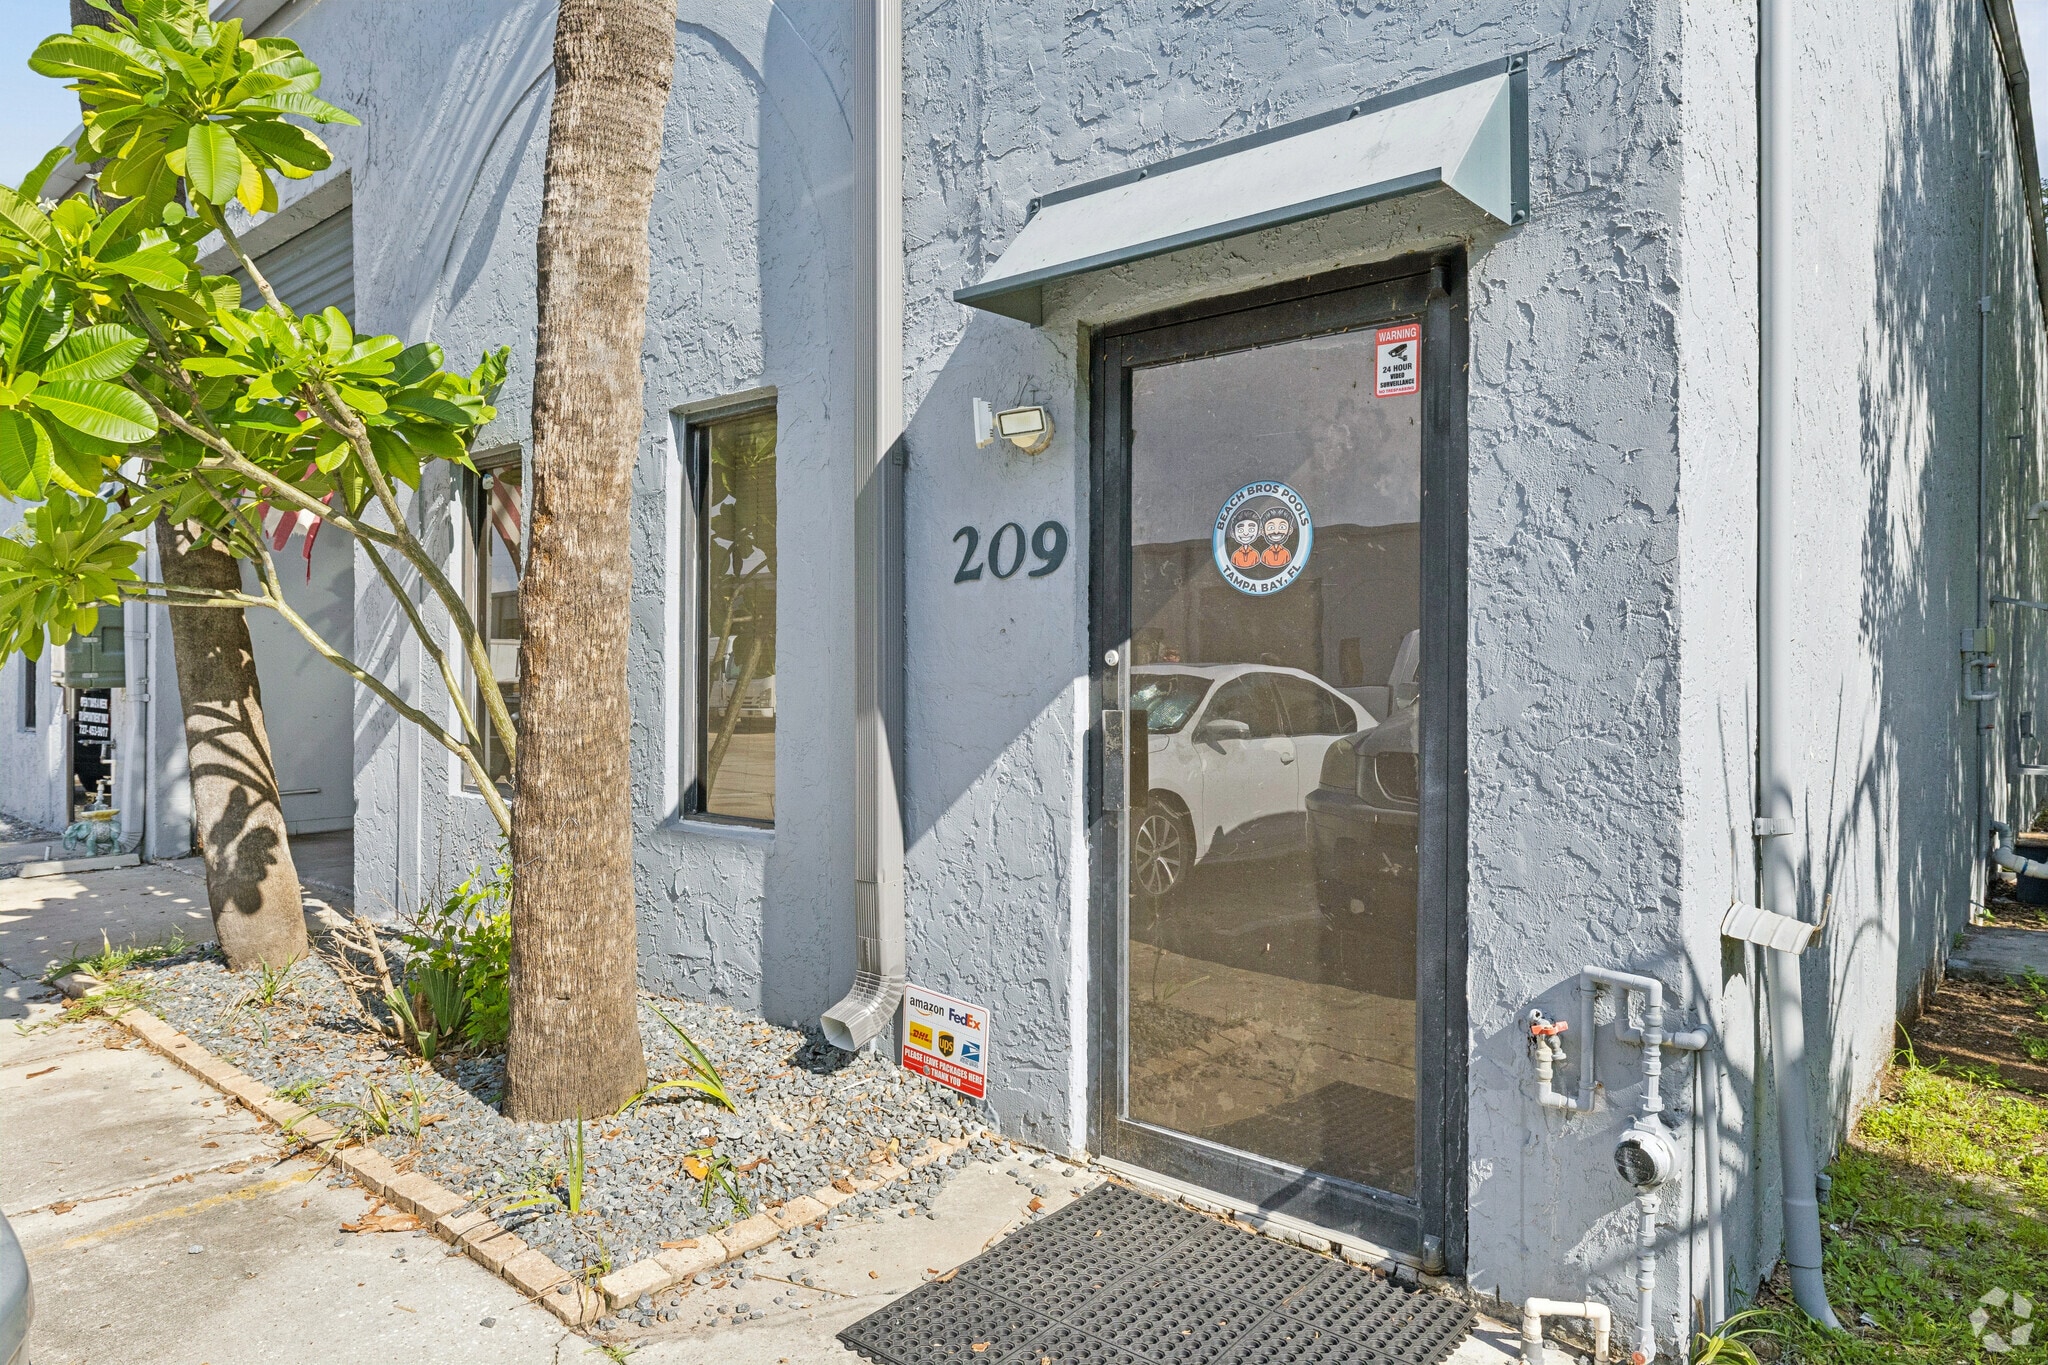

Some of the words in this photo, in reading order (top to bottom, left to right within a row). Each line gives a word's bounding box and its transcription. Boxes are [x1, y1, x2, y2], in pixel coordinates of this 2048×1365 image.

[1379, 327, 1416, 342] WARNING
[1393, 363, 1412, 372] HOUR
[1380, 378, 1414, 388] SURVEILLANCE
[1217, 491, 1245, 530] BEACH
[1247, 484, 1280, 495] BROS
[1281, 488, 1310, 527] POOLS
[953, 521, 1068, 583] 209
[1222, 565, 1257, 592] TAMPA
[1261, 577, 1288, 592] BAY,
[1288, 564, 1302, 578] FL
[910, 997, 944, 1016] amazon
[949, 1008, 980, 1030] FedEx
[912, 1029, 929, 1042] DHL
[905, 1048, 922, 1062] PLEASE
[924, 1056, 939, 1068] LEAVE
[939, 1061, 968, 1080] PACKAGES
[968, 1073, 982, 1085] HERE
[931, 1067, 949, 1082] THANK
[950, 1075, 961, 1086] YOU
